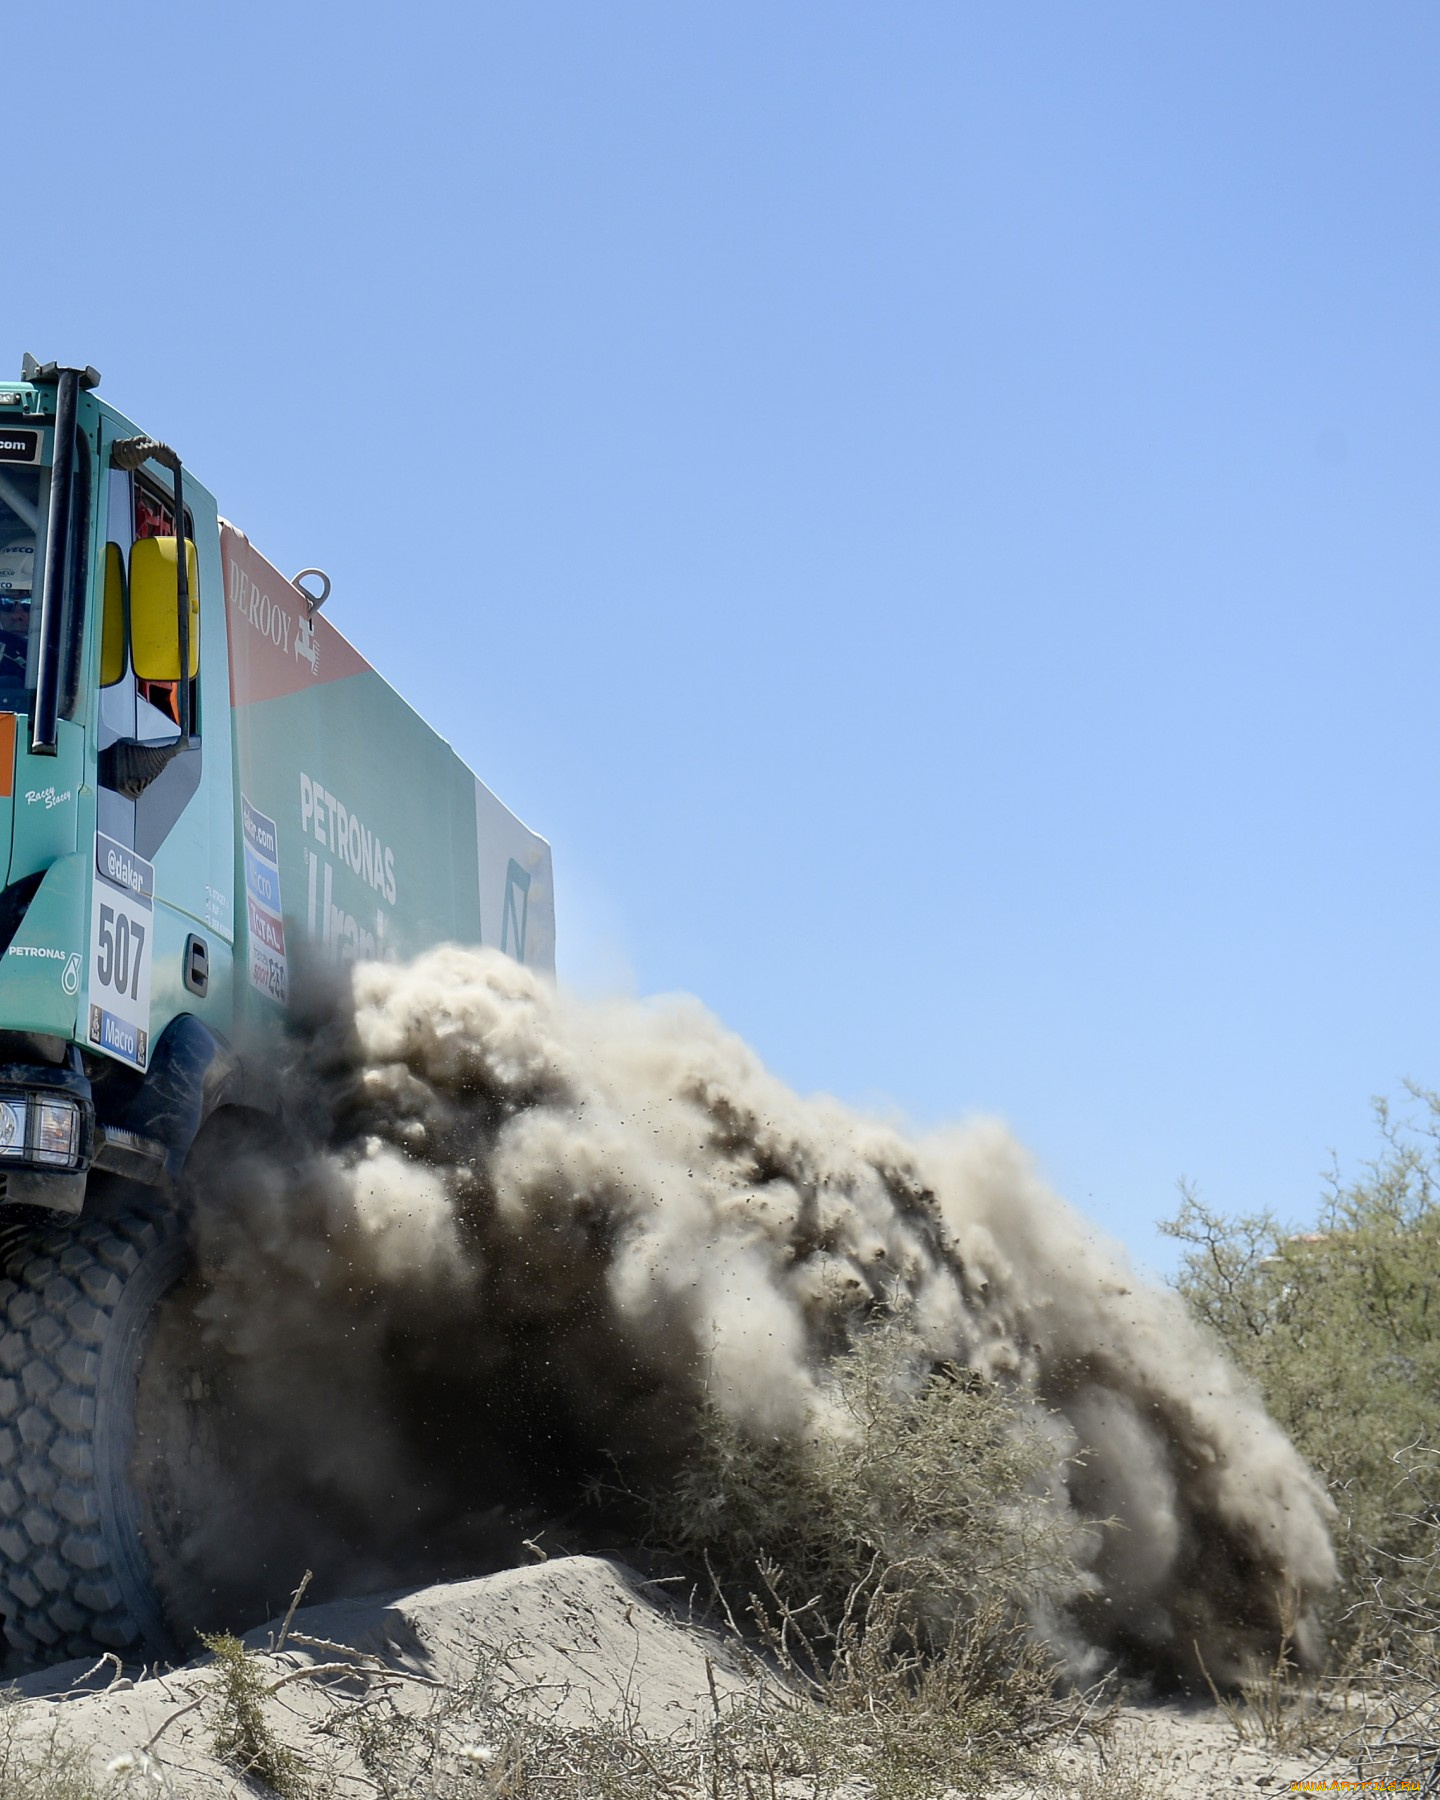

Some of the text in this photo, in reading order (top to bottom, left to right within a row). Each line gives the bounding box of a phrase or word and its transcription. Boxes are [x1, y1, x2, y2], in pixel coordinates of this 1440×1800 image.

[1, 546, 34, 554] IVECO
[229, 559, 292, 654] DE ROOY
[25, 786, 55, 805] Racey
[45, 790, 71, 809] Stacey
[300, 771, 397, 906] PETRONAS
[107, 850, 144, 893] @dakar
[9, 946, 66, 961] PETRONAS
[97, 902, 146, 1001] 507
[105, 1018, 134, 1055] Macro
